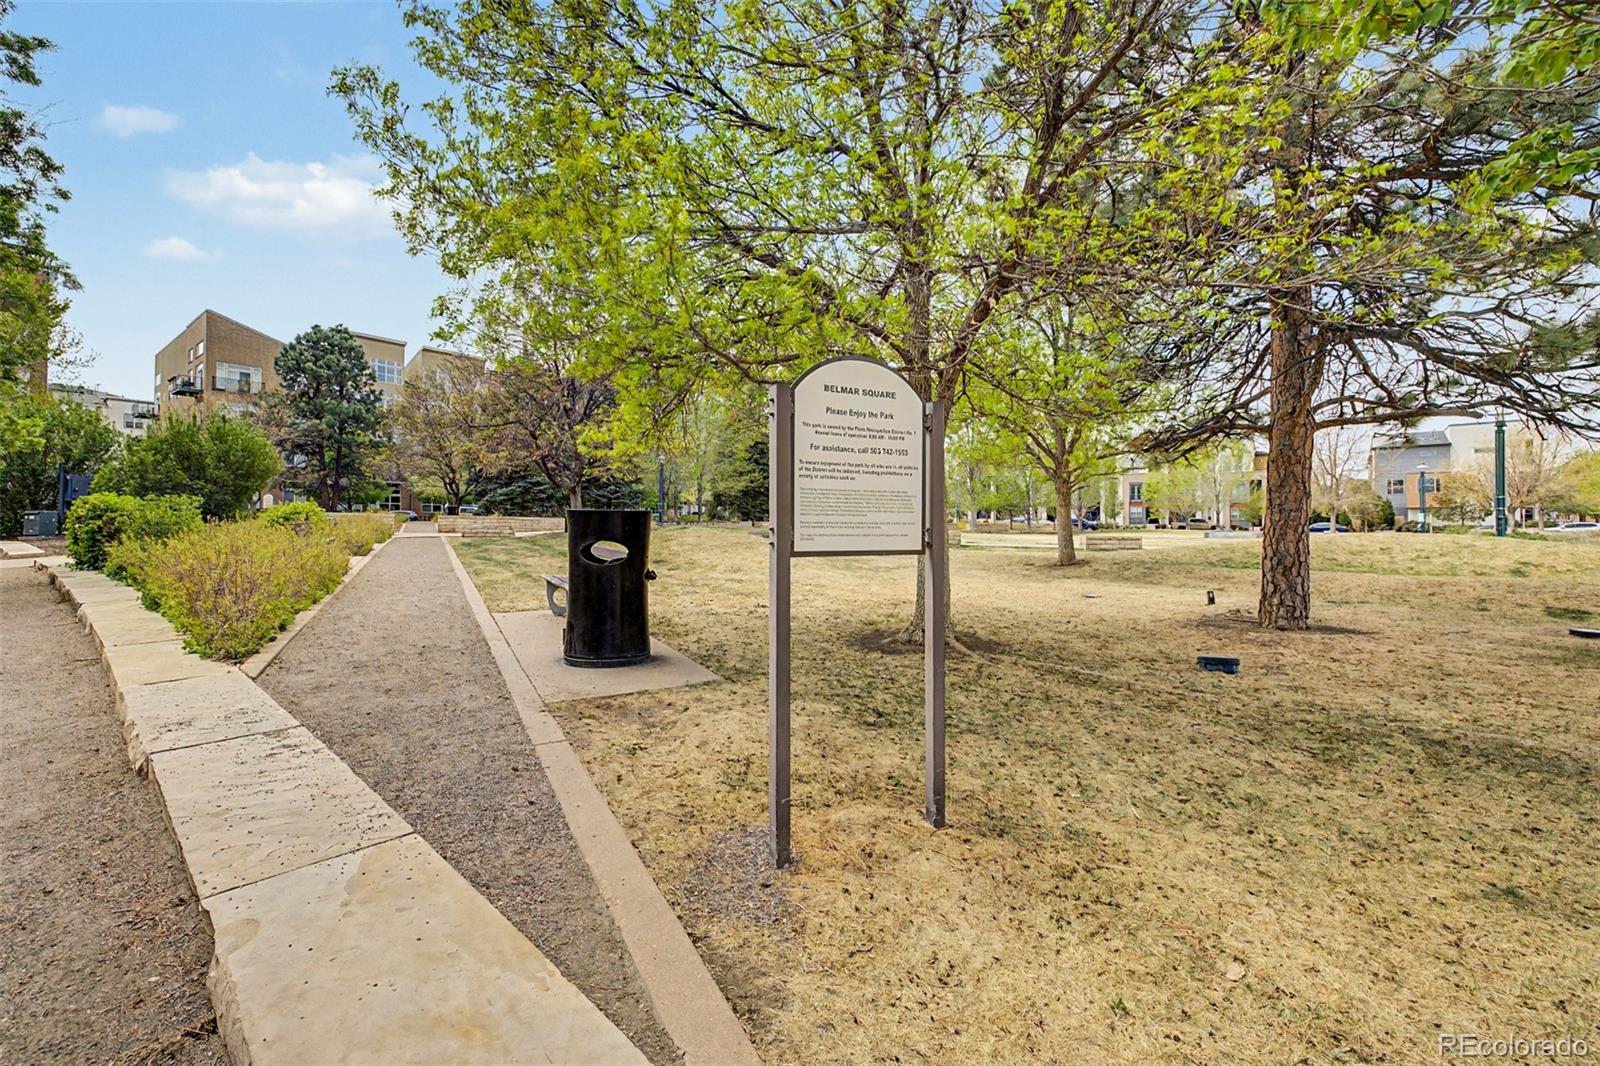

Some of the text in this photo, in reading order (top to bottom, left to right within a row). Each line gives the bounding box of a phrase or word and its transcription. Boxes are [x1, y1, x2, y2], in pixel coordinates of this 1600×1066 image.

[824, 384, 896, 399] BELMAR SQUARE
[826, 406, 894, 420] Please Enjoy the Park
[810, 443, 820, 451] For
[822, 445, 856, 454] assistance,
